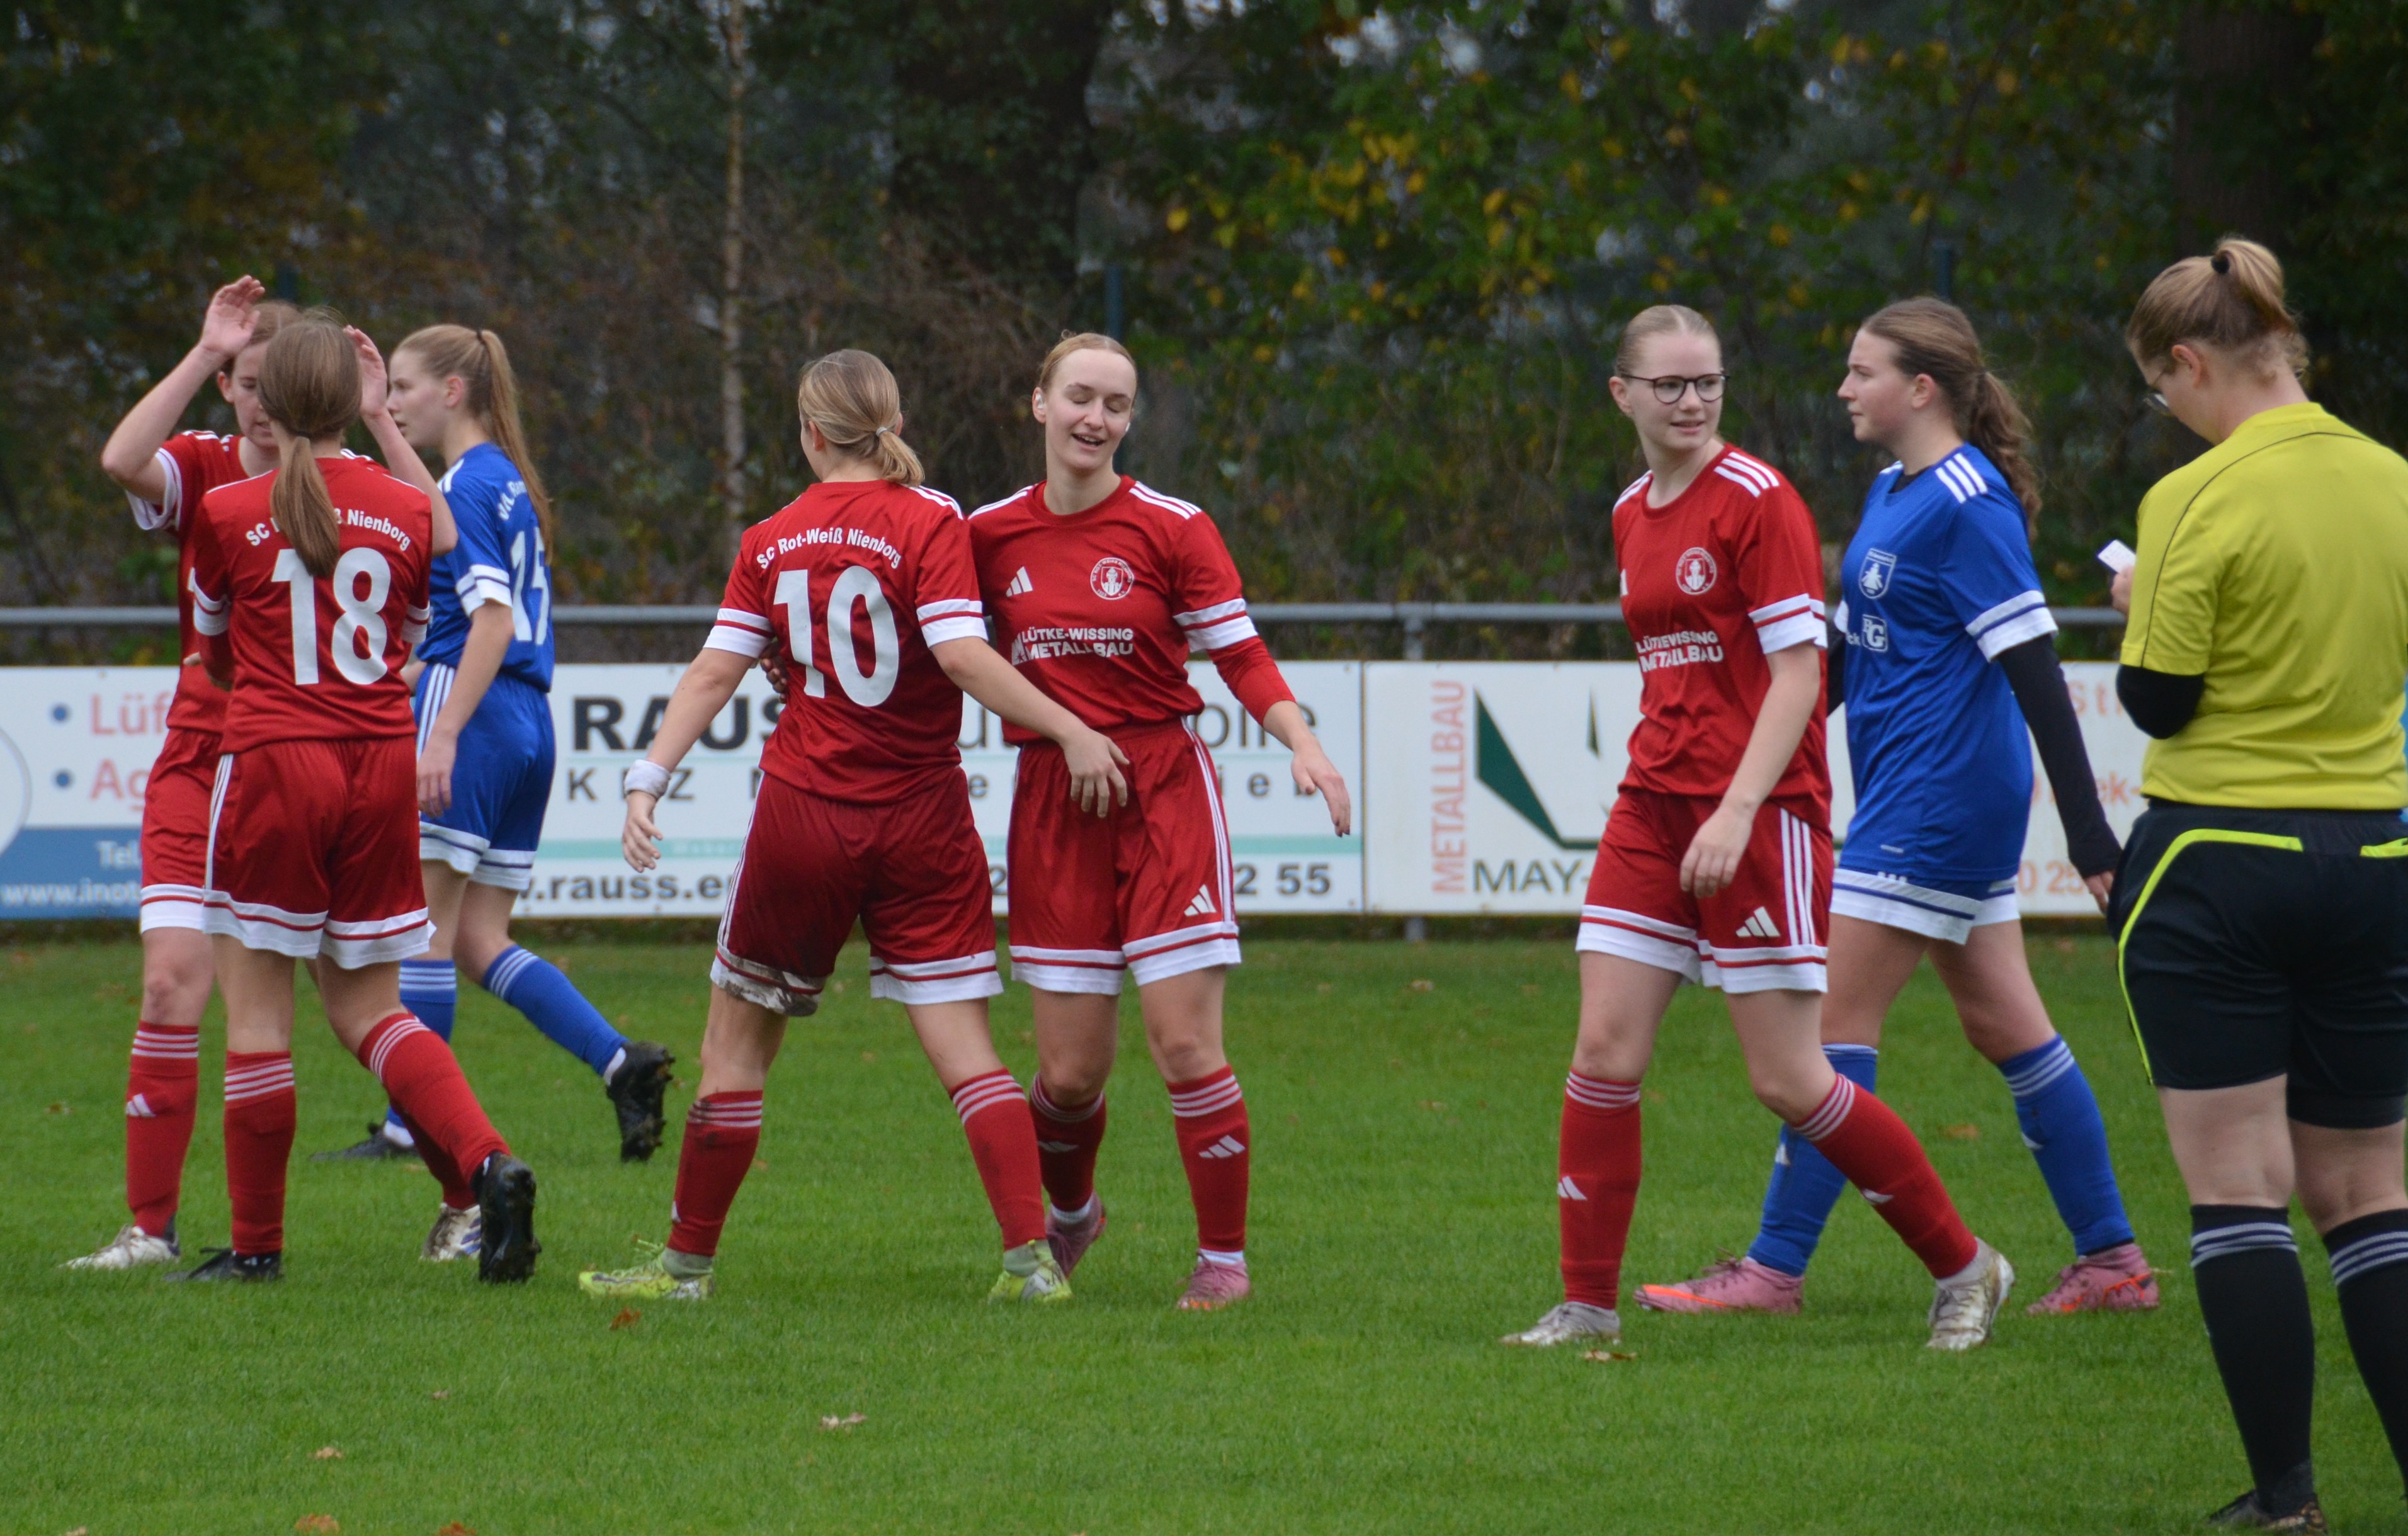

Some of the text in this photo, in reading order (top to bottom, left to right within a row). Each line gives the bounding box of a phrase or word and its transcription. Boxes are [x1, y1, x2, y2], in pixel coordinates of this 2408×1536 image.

[246, 523, 270, 546] SC
[348, 509, 411, 551] Nienborg
[757, 527, 902, 569] SC Rot-Weiß Nienborg
[271, 547, 391, 686] 18
[773, 565, 900, 707] 10
[1021, 626, 1133, 643] LÜTKE-WISSING
[1025, 641, 1133, 661] METALLBAU
[1640, 645, 1724, 672] MTALLBAU
[91, 691, 172, 735] Lüf
[91, 759, 149, 812] Ag
[1431, 679, 1467, 894] METALLBAU
[1, 877, 140, 906] www.inot
[516, 874, 734, 900] .rauss.e
[1277, 862, 1332, 896] 55
